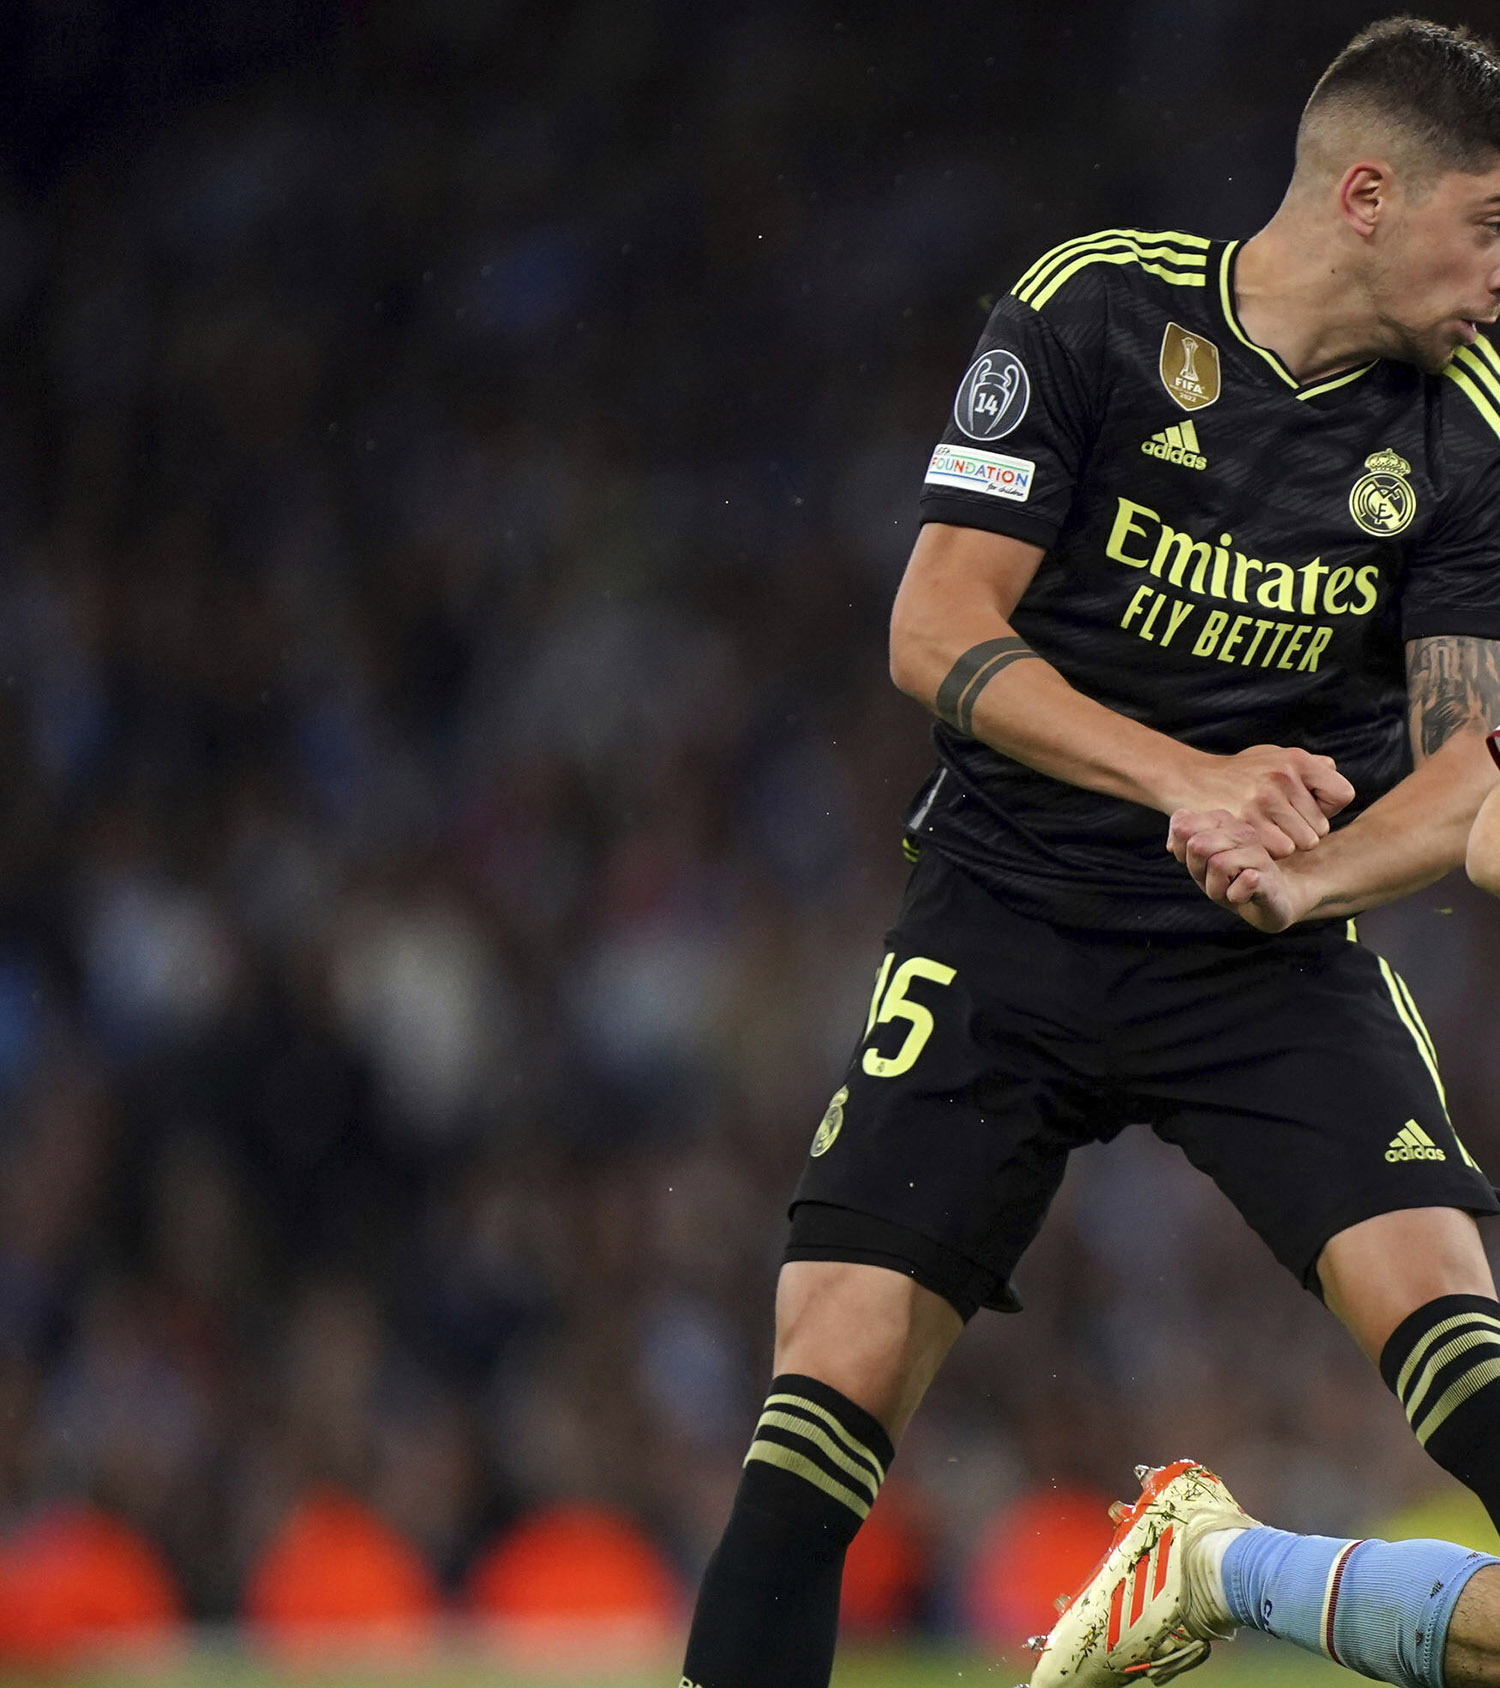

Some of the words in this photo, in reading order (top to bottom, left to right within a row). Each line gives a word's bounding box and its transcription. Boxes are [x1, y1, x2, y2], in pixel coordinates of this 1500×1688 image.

[1174, 377, 1203, 394] FIFA
[974, 391, 999, 416] 14
[1141, 440, 1207, 471] adidas
[1105, 497, 1380, 616] Emirates
[1120, 584, 1195, 648] FLY
[1191, 609, 1334, 673] BETTER
[860, 952, 958, 1078] 15
[1384, 1144, 1447, 1163] adidas
